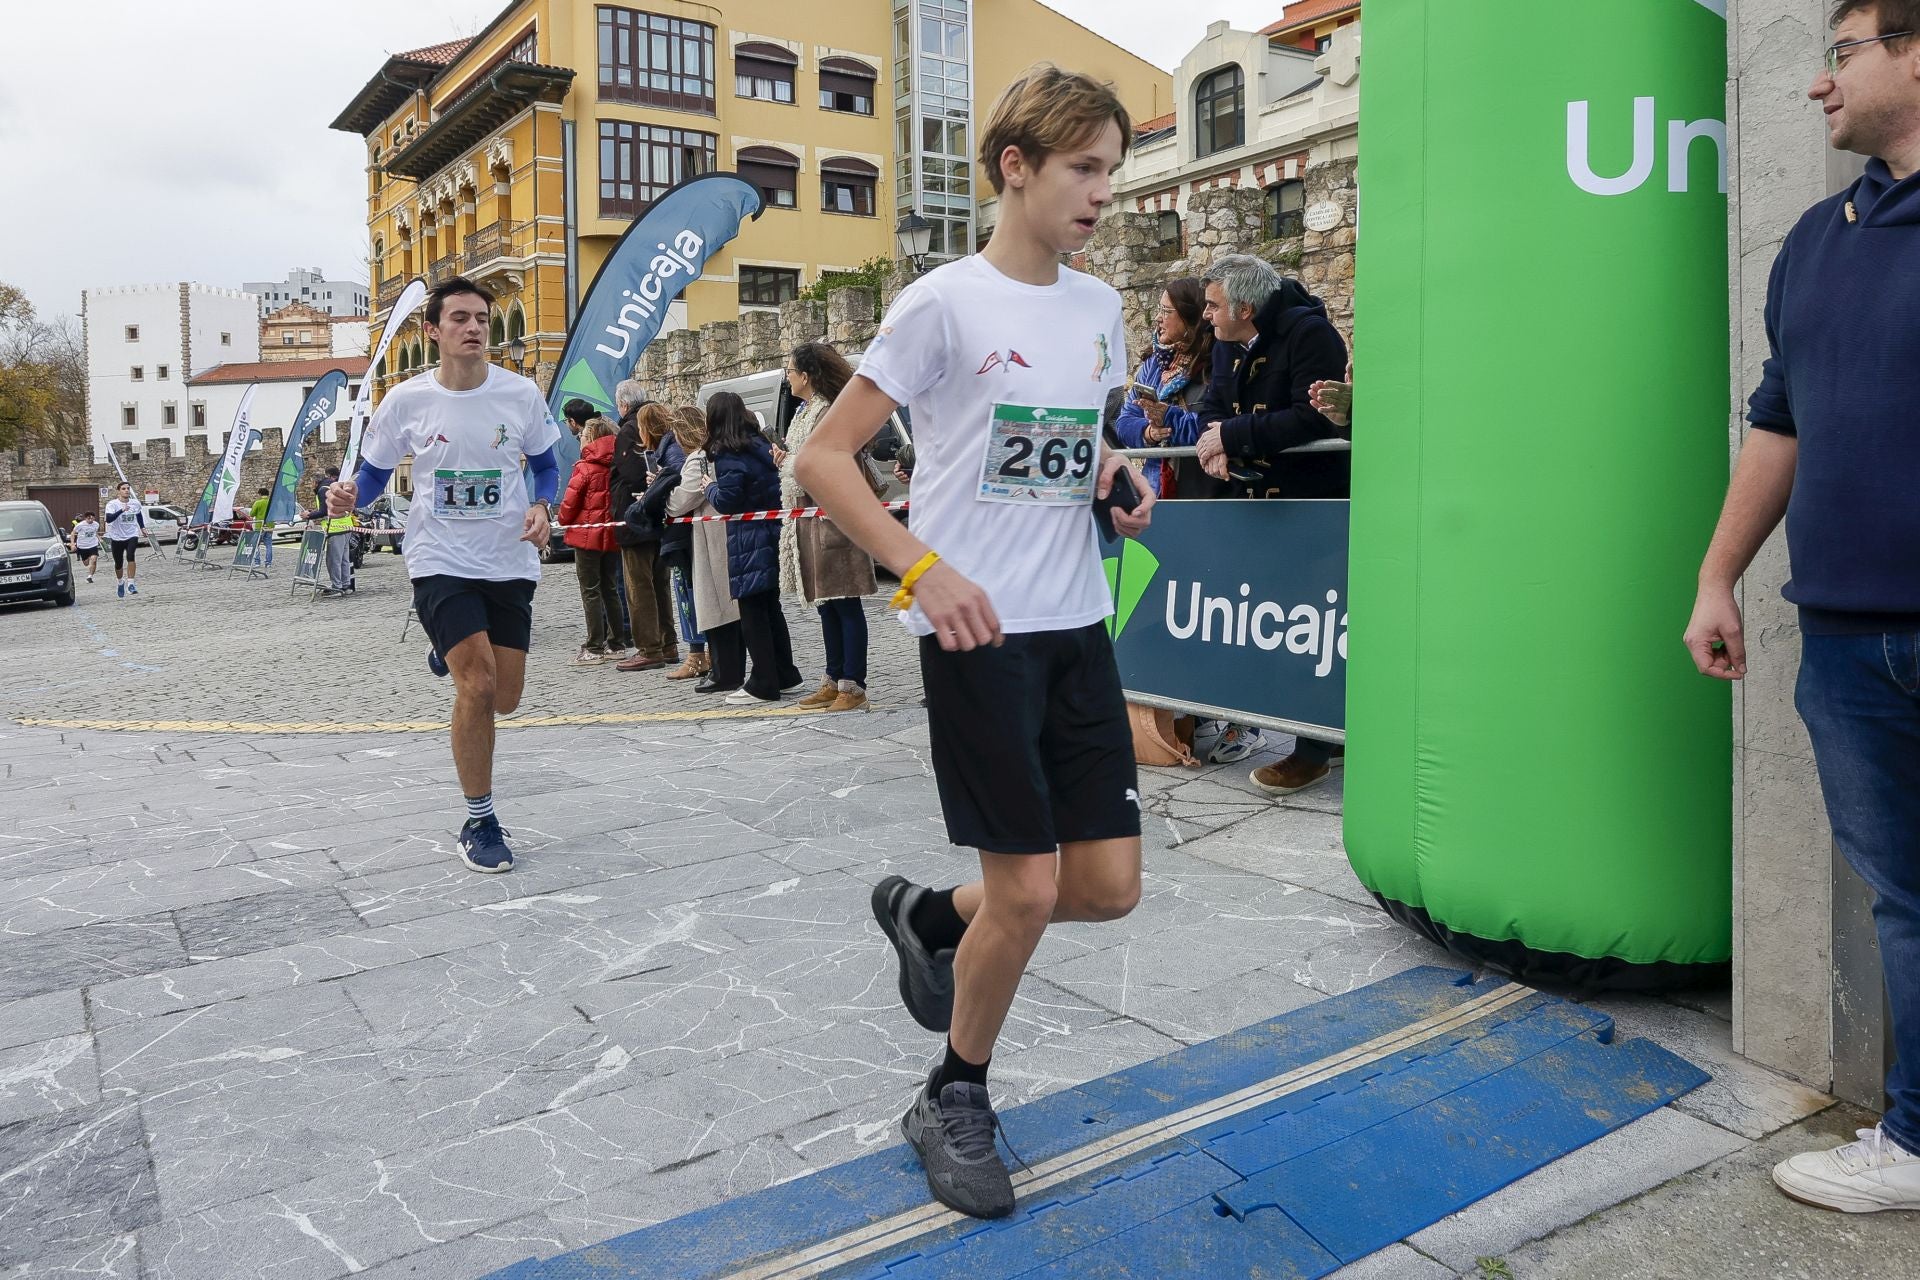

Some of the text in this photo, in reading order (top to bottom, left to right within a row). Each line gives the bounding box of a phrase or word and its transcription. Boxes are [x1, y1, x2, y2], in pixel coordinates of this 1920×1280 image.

[1566, 96, 1727, 195] Un
[595, 229, 704, 359] Unicaja
[230, 411, 249, 466] Unicaja
[998, 436, 1093, 479] 269
[444, 484, 500, 506] 116
